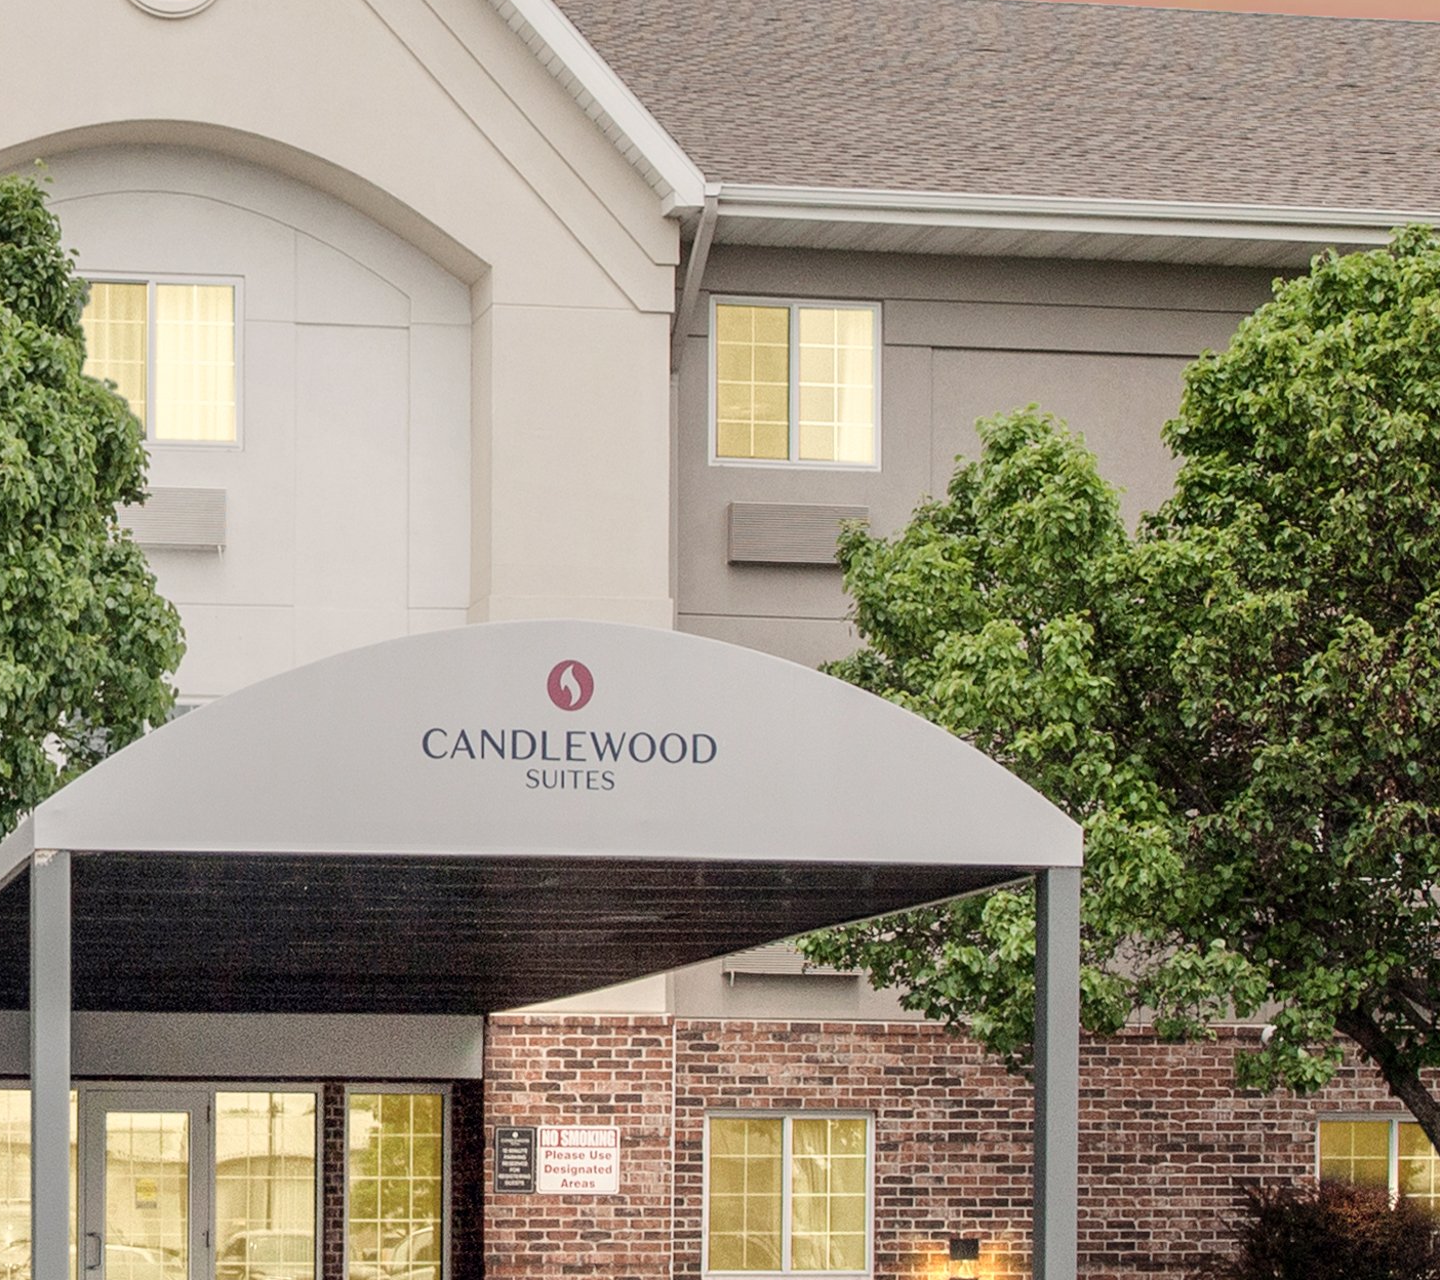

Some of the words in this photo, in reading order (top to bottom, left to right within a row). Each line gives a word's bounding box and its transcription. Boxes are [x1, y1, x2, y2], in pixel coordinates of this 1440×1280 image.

[422, 728, 717, 764] CANDLEWOOD
[526, 769, 615, 790] SUITES
[541, 1129, 559, 1147] NO
[560, 1130, 616, 1147] SMOKING
[545, 1150, 585, 1160] Please
[589, 1150, 612, 1160] Use
[544, 1164, 612, 1176] Designated
[561, 1178, 595, 1188] Areas
